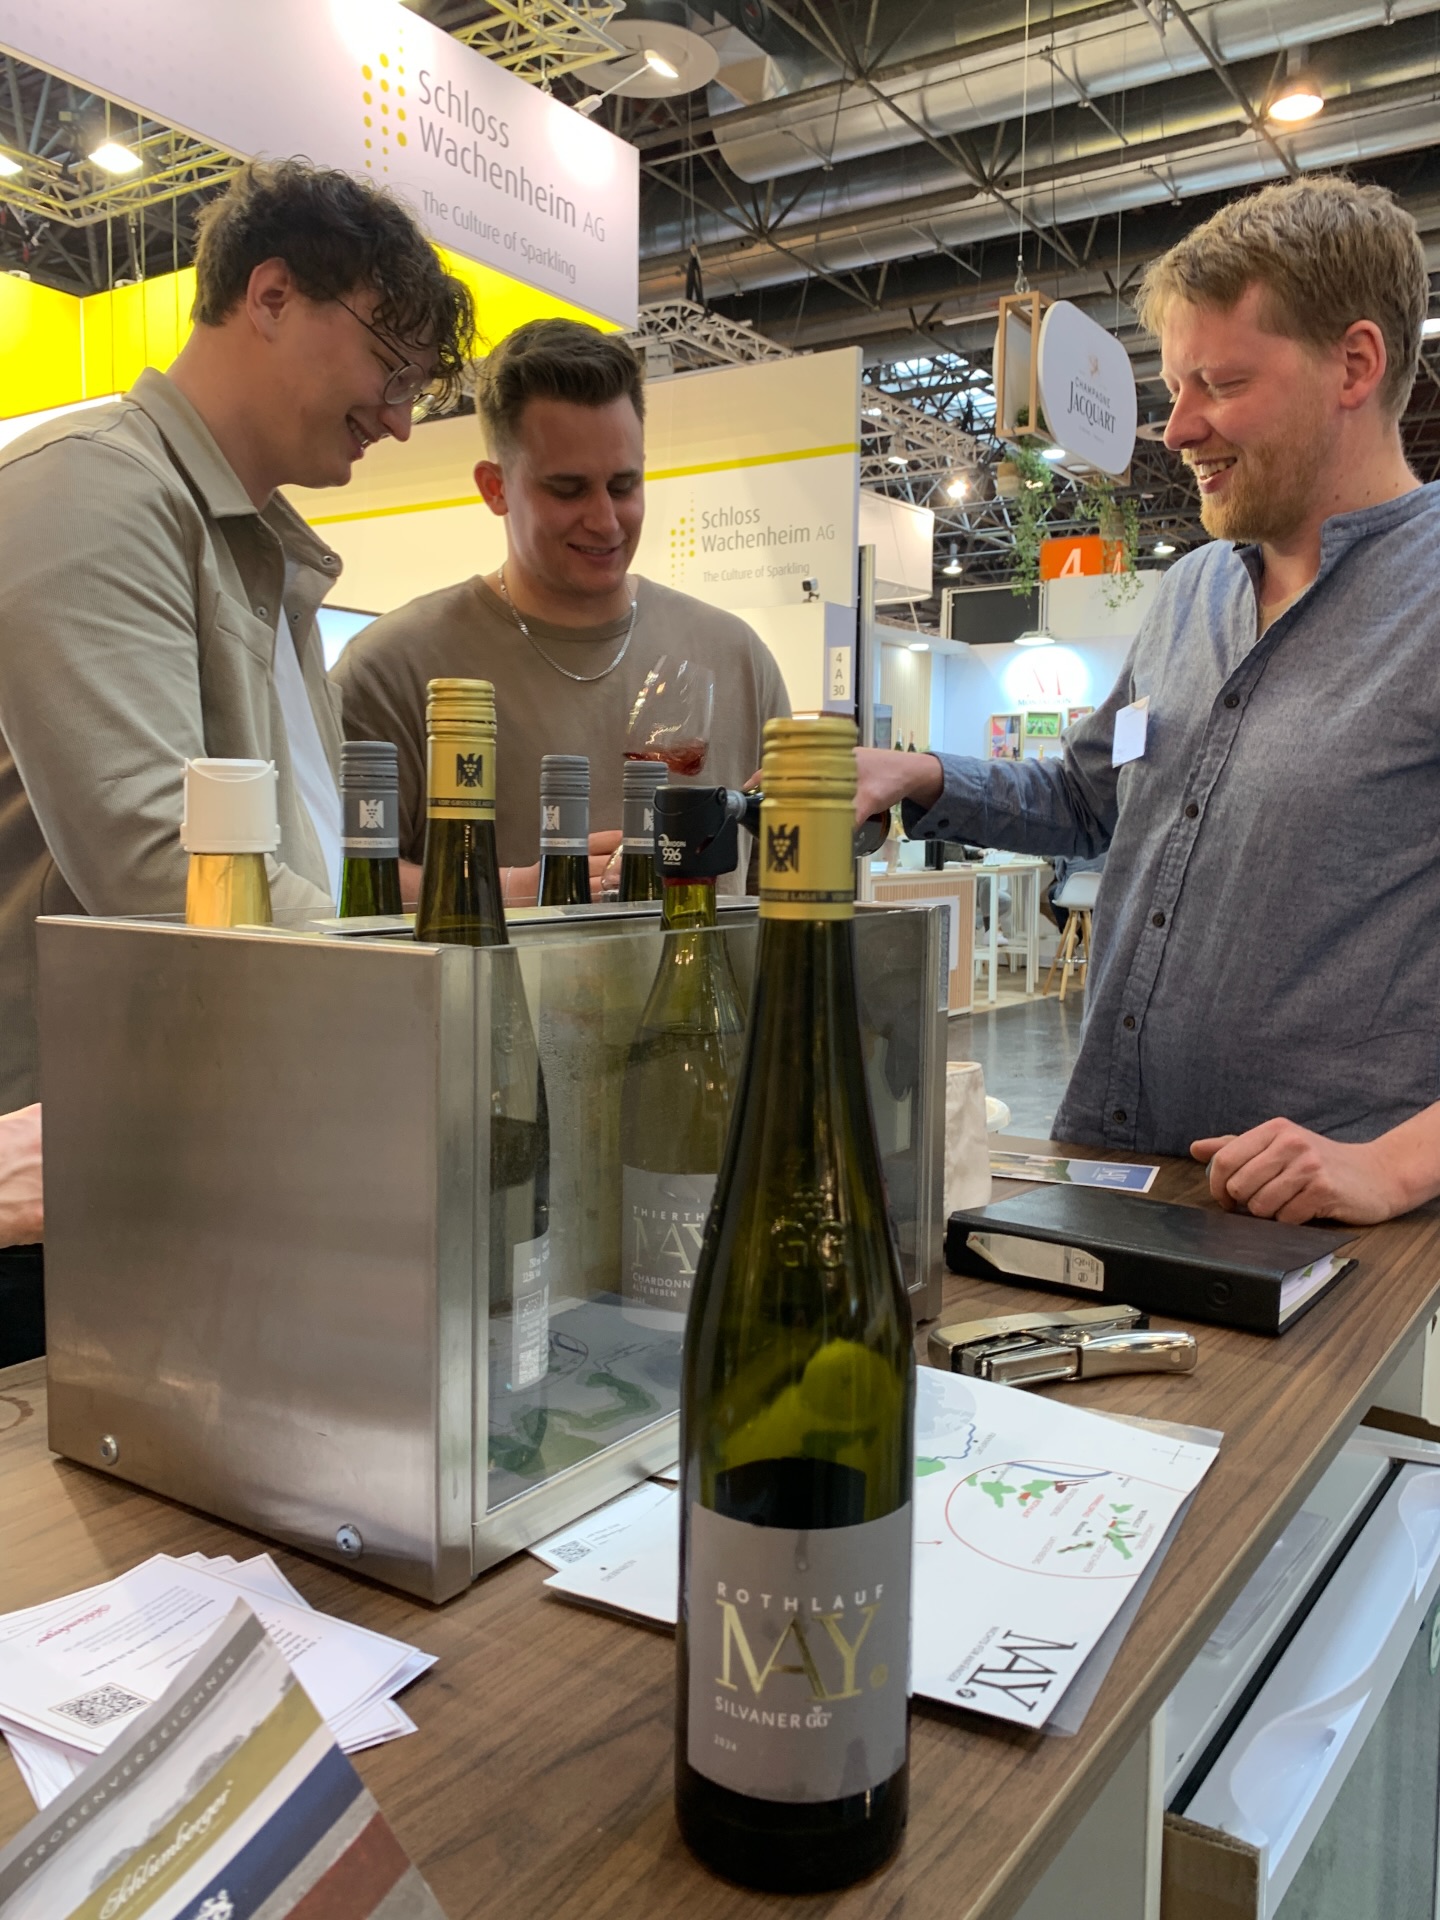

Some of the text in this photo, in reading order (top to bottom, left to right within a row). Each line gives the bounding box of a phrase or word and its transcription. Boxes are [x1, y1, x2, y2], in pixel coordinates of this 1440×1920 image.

[419, 69, 510, 148] Schloss
[419, 115, 605, 242] Wachenheim AG
[422, 190, 577, 284] The Culture of Sparkling
[1067, 381, 1116, 434] JACQUART
[1075, 376, 1111, 409] CHAMPAGNE
[701, 506, 761, 529] Schloss
[701, 524, 835, 553] Wachenheim AG
[703, 562, 810, 583] The Culture of Sparkling
[1060, 547, 1085, 579] 4
[835, 652, 843, 663] 4
[835, 668, 843, 680] A
[832, 684, 846, 696] 30
[632, 1205, 706, 1221] THIERTH
[632, 1272, 693, 1289] CHARDONN
[716, 1581, 884, 1612] ROTHLAUF
[715, 1696, 801, 1729] SILVANER
[23, 1656, 236, 1868] PROBENVERZEICHNIS
[99, 1785, 232, 1920] Schlumberger
